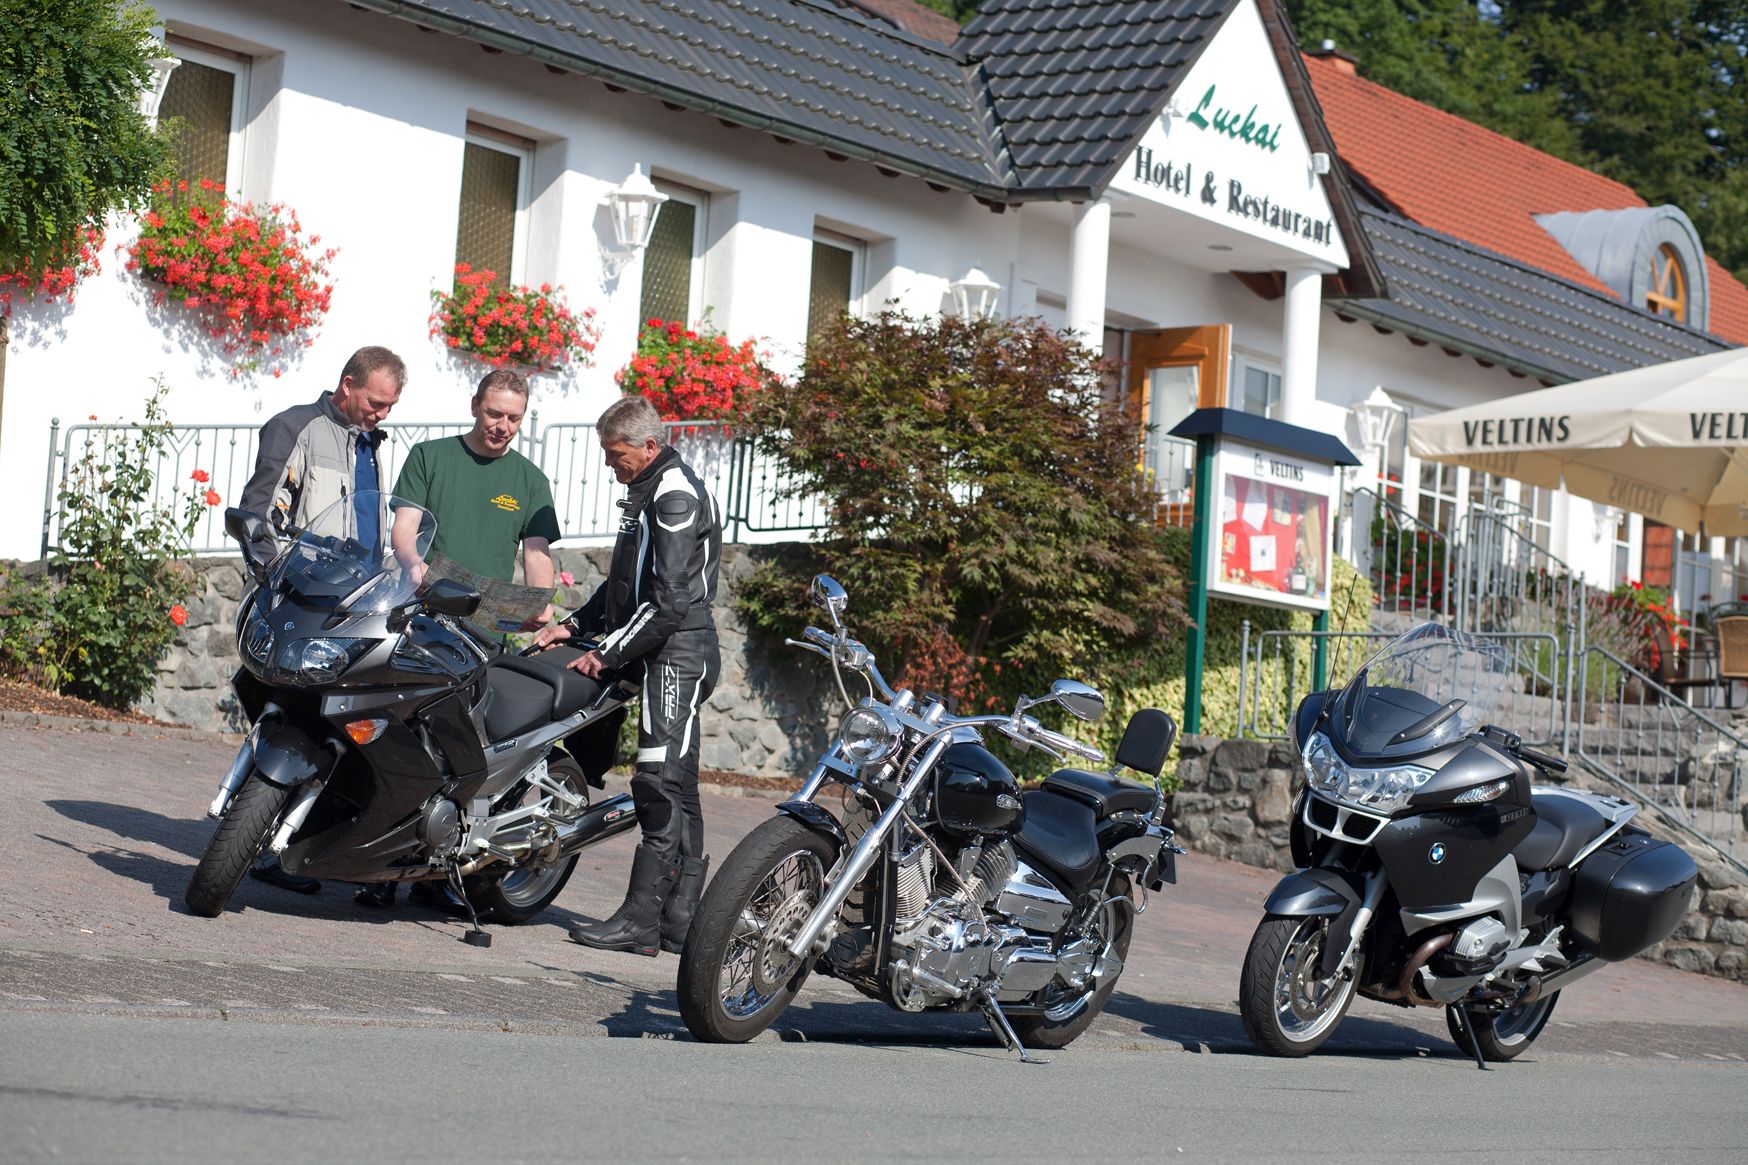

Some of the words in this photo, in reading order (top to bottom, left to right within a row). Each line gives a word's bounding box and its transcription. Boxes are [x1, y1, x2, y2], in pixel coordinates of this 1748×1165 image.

[1186, 84, 1281, 152] Luckai
[1134, 145, 1192, 198] Hotel
[1200, 171, 1217, 207] &
[1227, 178, 1333, 246] Restaurant
[1463, 415, 1570, 446] VELTINS
[1270, 460, 1304, 482] VELTINS
